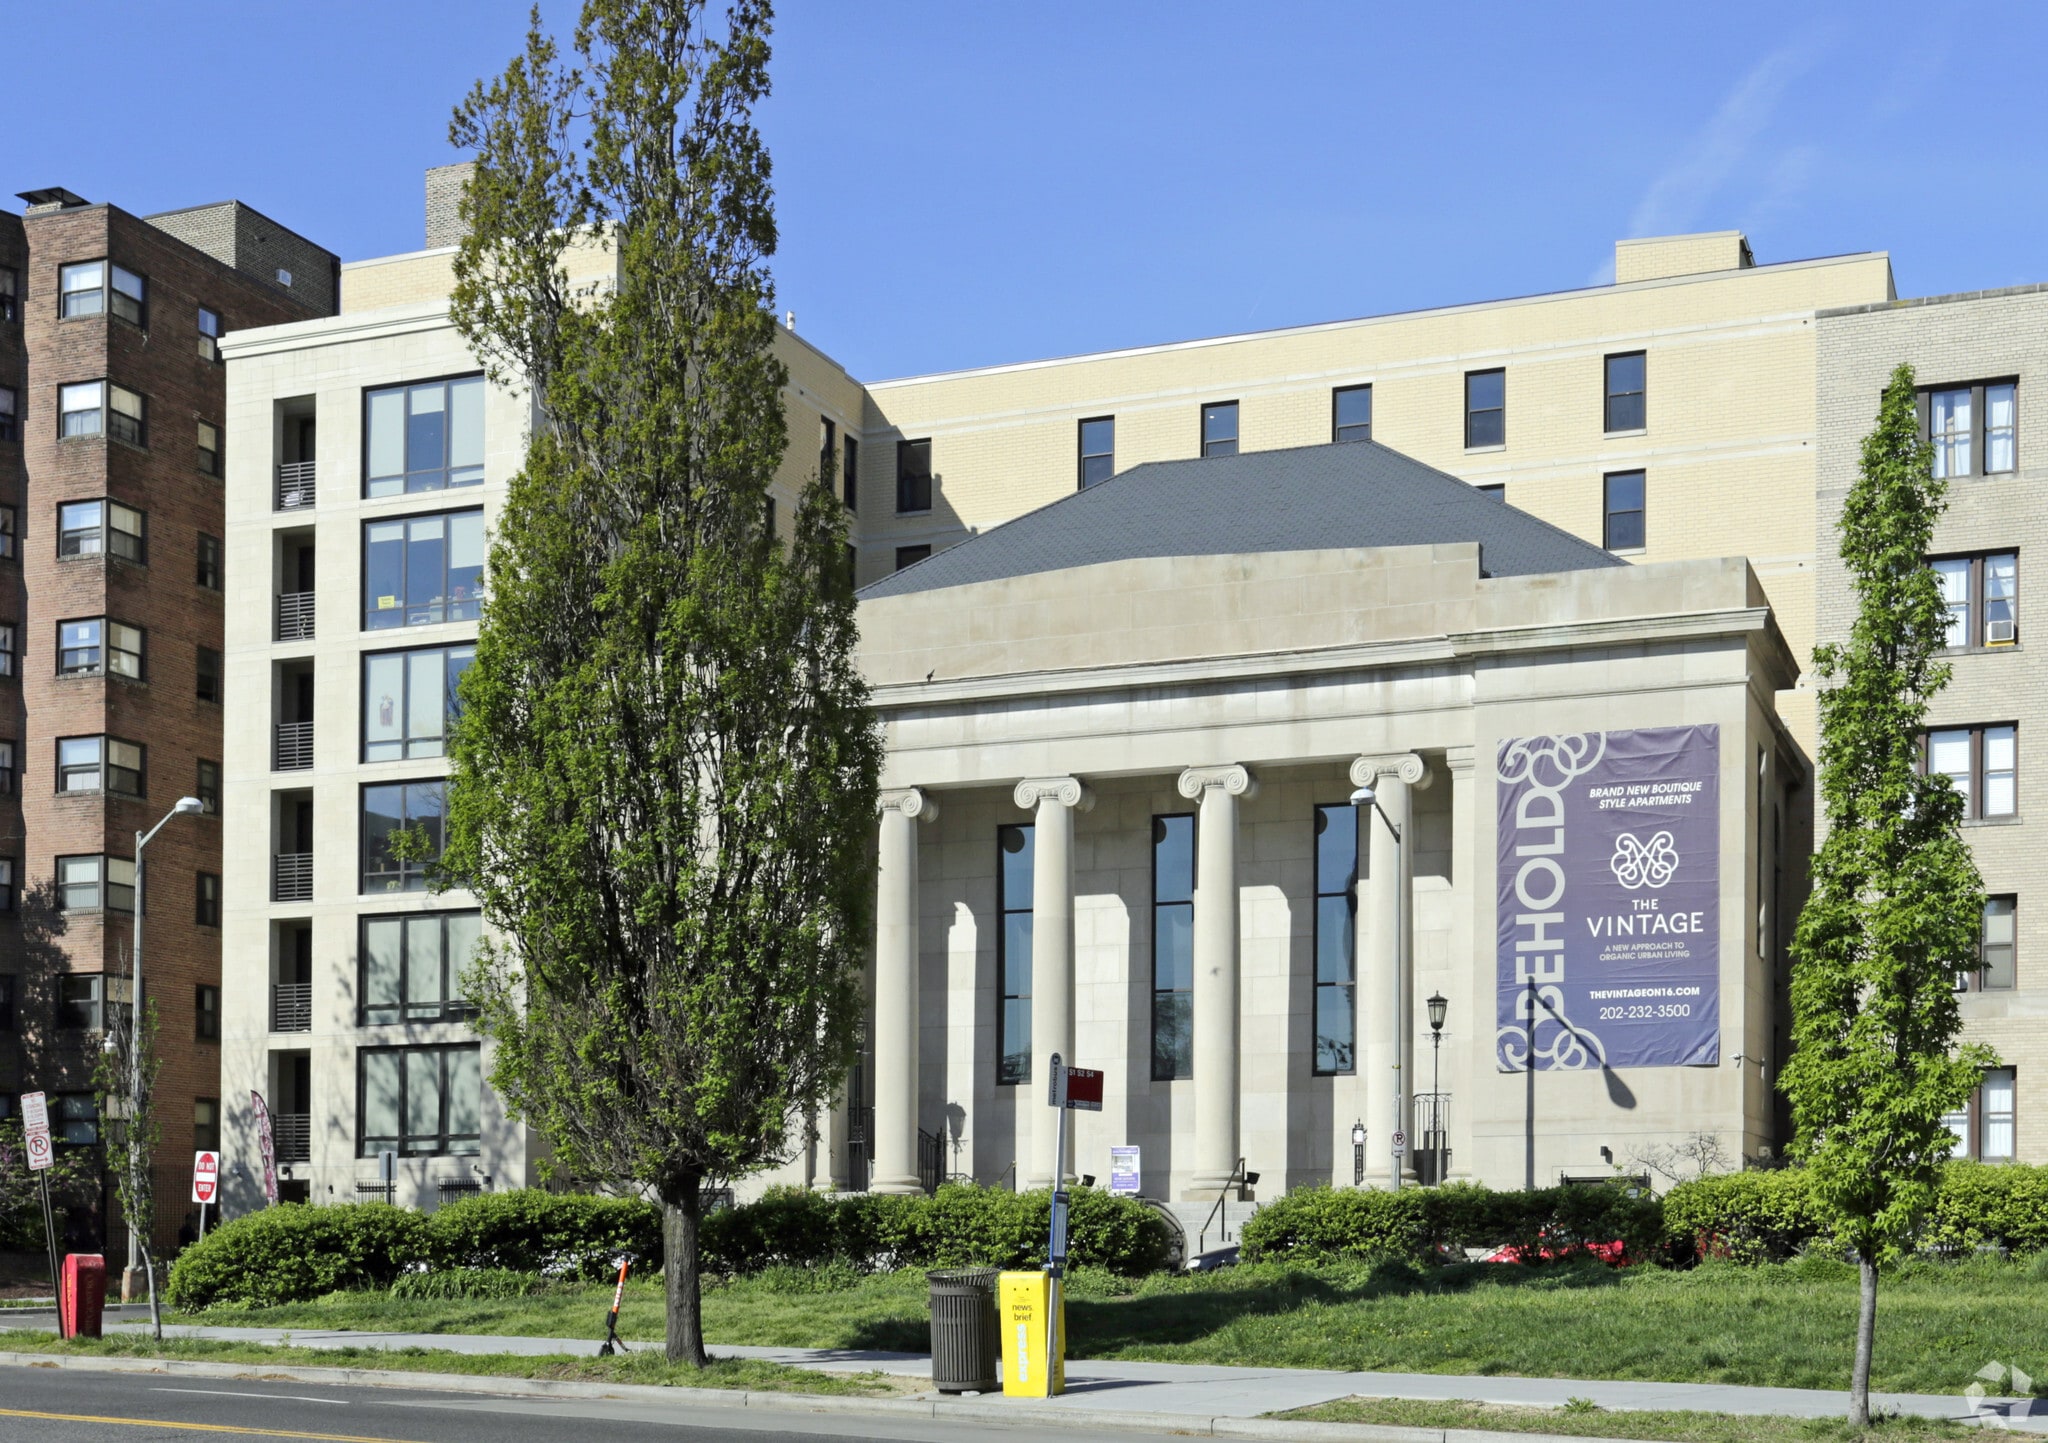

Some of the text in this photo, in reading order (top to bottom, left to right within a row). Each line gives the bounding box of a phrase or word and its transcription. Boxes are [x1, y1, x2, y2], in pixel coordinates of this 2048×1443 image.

[1589, 781, 1702, 798] BRAND NEW BOUTIQUE
[1599, 794, 1692, 809] STYLE APARTMENTS
[1515, 786, 1566, 1021] BEHOLD
[1631, 898, 1659, 911] THE
[1586, 911, 1704, 938] VINTAGE
[1612, 944, 1629, 952] NEW
[1631, 942, 1673, 951] APPROACH
[1674, 941, 1684, 949] TO
[1599, 949, 1690, 961] ORGANIC URBAN LIVING
[1589, 986, 1700, 1000] THEVINTAGEON16.COM
[1599, 1003, 1690, 1020] 202-232-3500
[198, 1161, 215, 1170] DO NOT
[198, 1183, 212, 1193] ENTER
